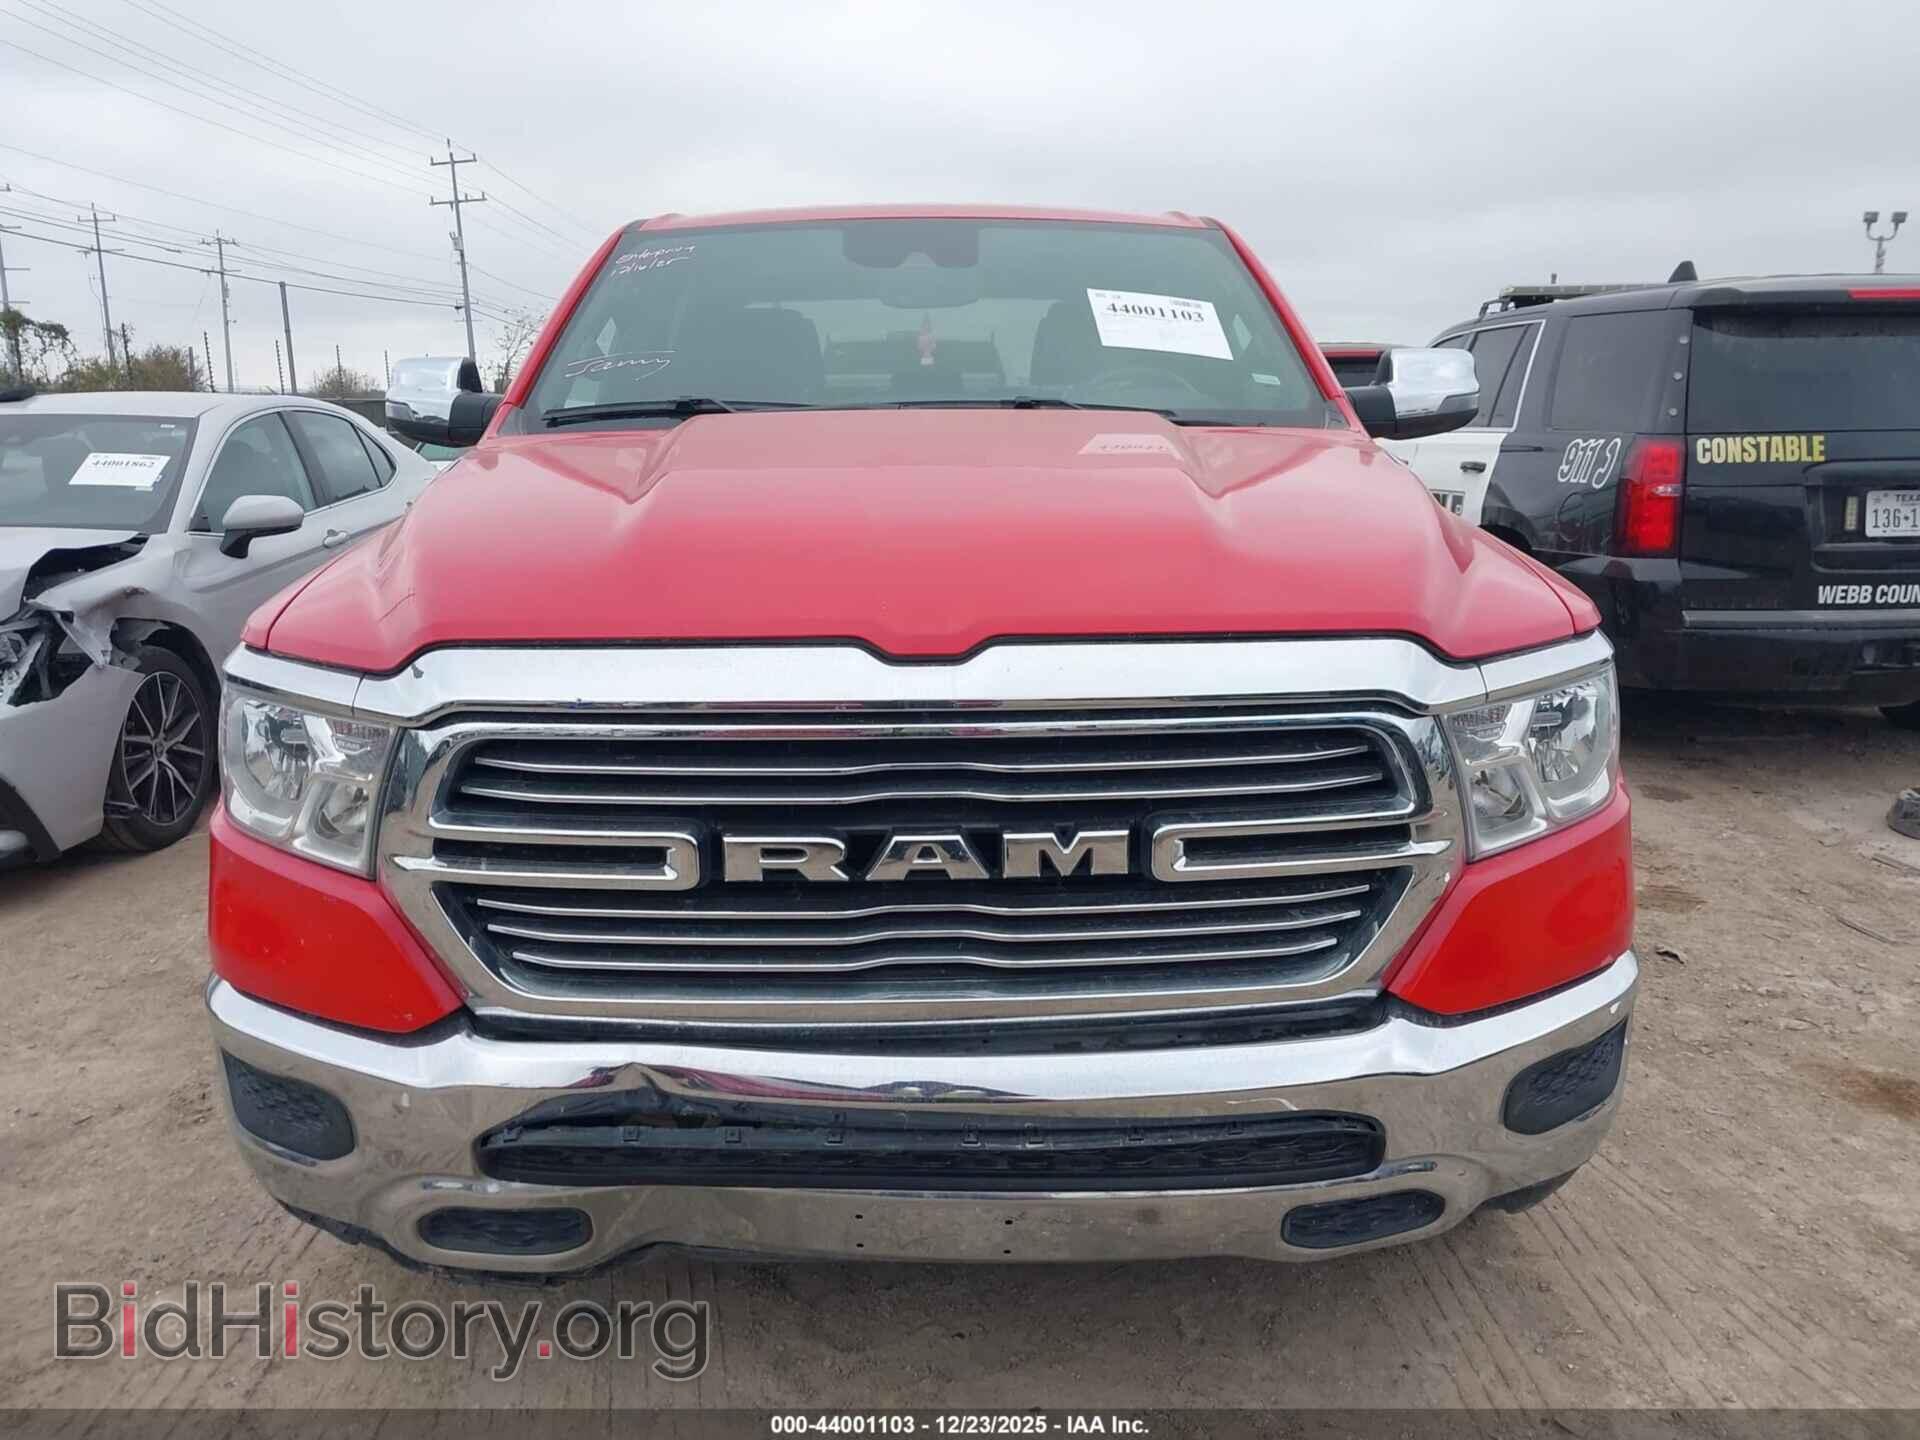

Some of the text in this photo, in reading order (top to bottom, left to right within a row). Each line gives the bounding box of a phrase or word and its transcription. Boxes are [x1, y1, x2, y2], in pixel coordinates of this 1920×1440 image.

[1106, 302, 1205, 322] 44001103
[1696, 436, 1825, 464] CONSTABLE
[1818, 585, 1873, 604] WEBB
[722, 830, 1130, 882] RAM
